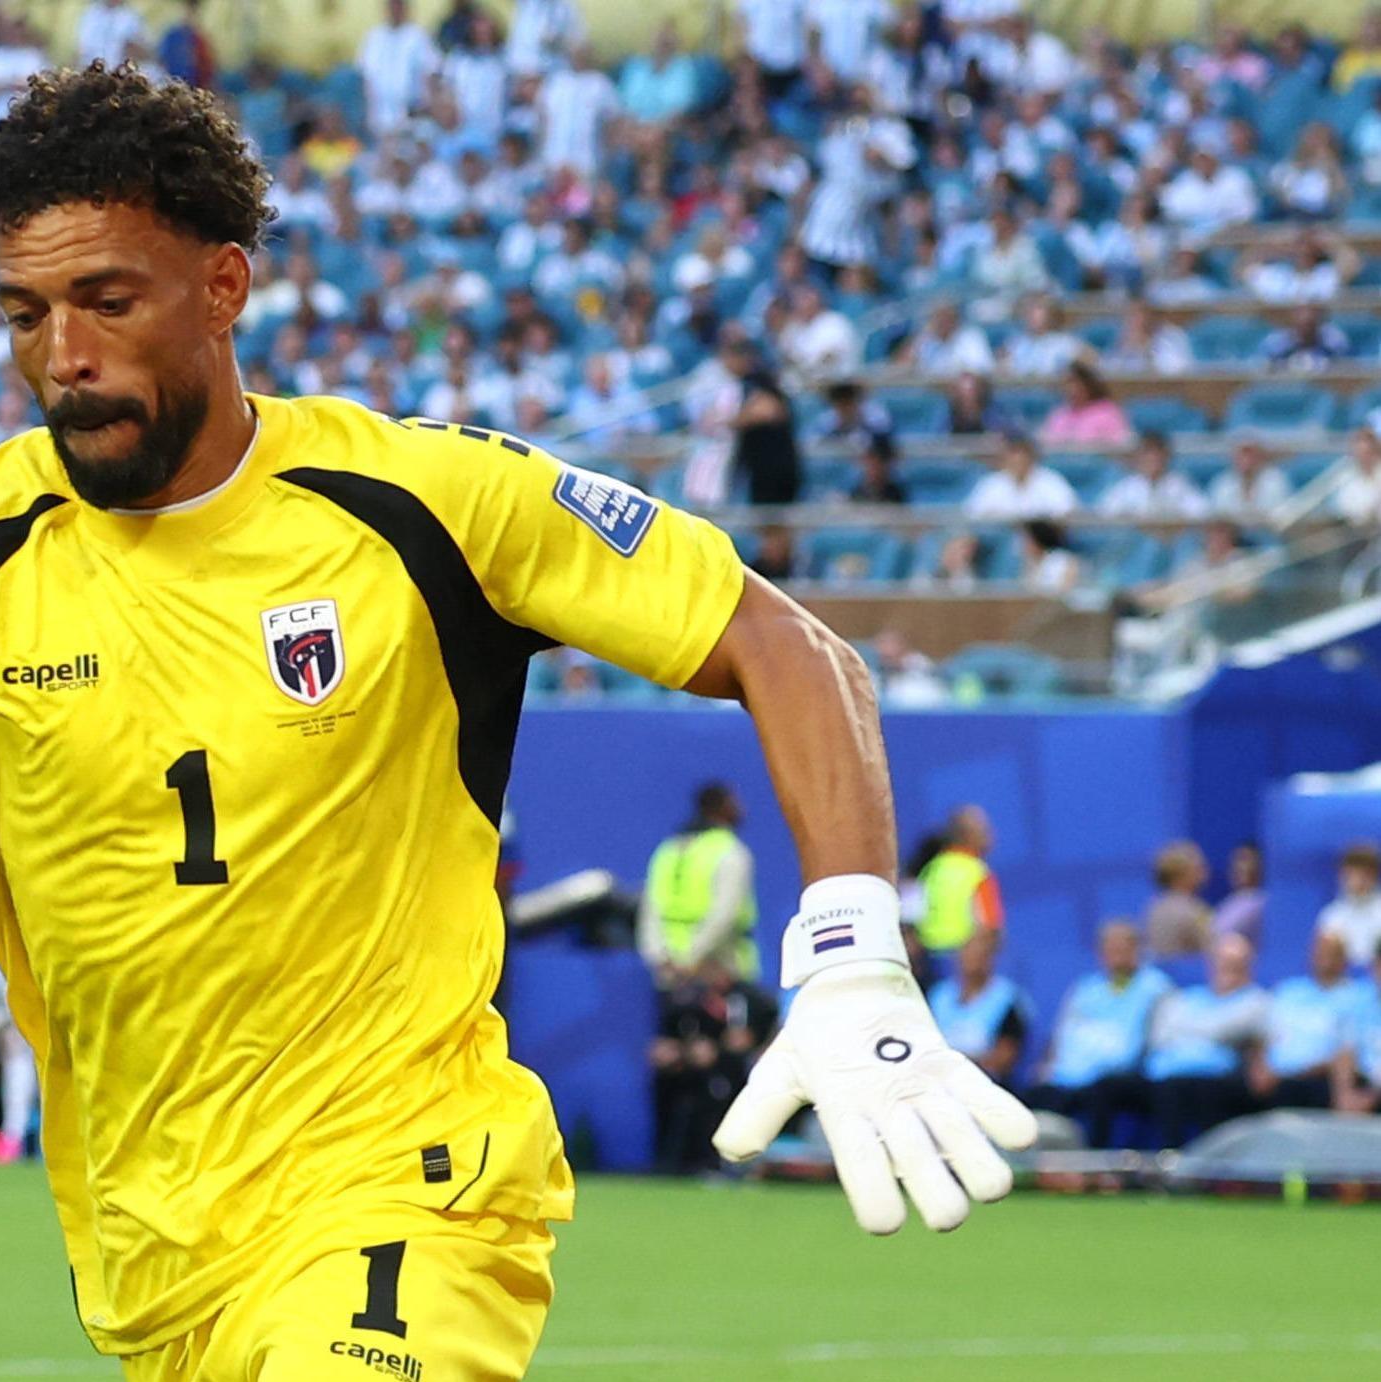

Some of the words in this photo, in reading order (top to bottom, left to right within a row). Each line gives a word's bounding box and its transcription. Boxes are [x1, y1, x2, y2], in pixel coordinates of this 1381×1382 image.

[269, 605, 329, 628] FCF
[2, 653, 99, 690] capelli
[46, 680, 100, 692] SPORT
[165, 749, 229, 885] 1
[351, 1240, 407, 1340] 1
